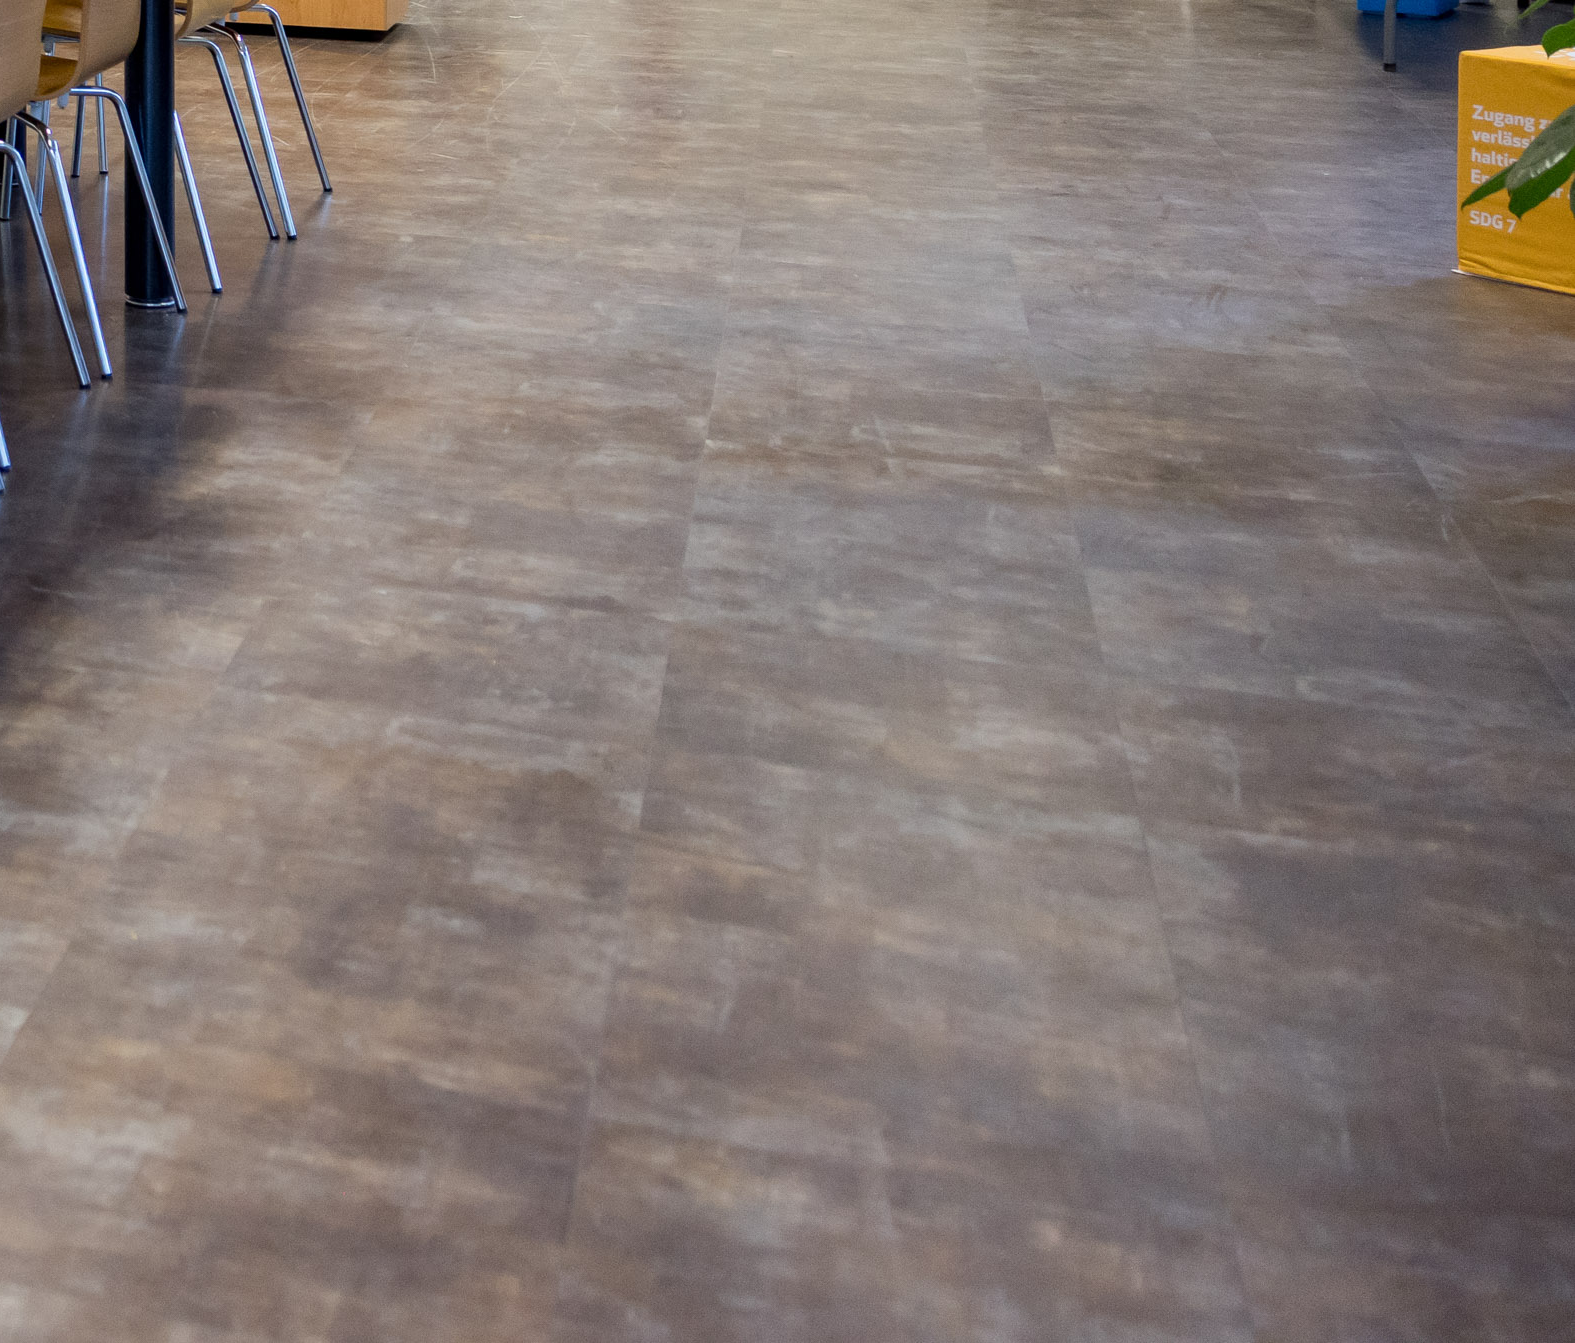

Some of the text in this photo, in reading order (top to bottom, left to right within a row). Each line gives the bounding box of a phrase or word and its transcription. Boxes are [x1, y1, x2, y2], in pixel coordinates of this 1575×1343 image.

[1472, 104, 1535, 132] Zugang
[1470, 210, 1516, 234] SDG 7
